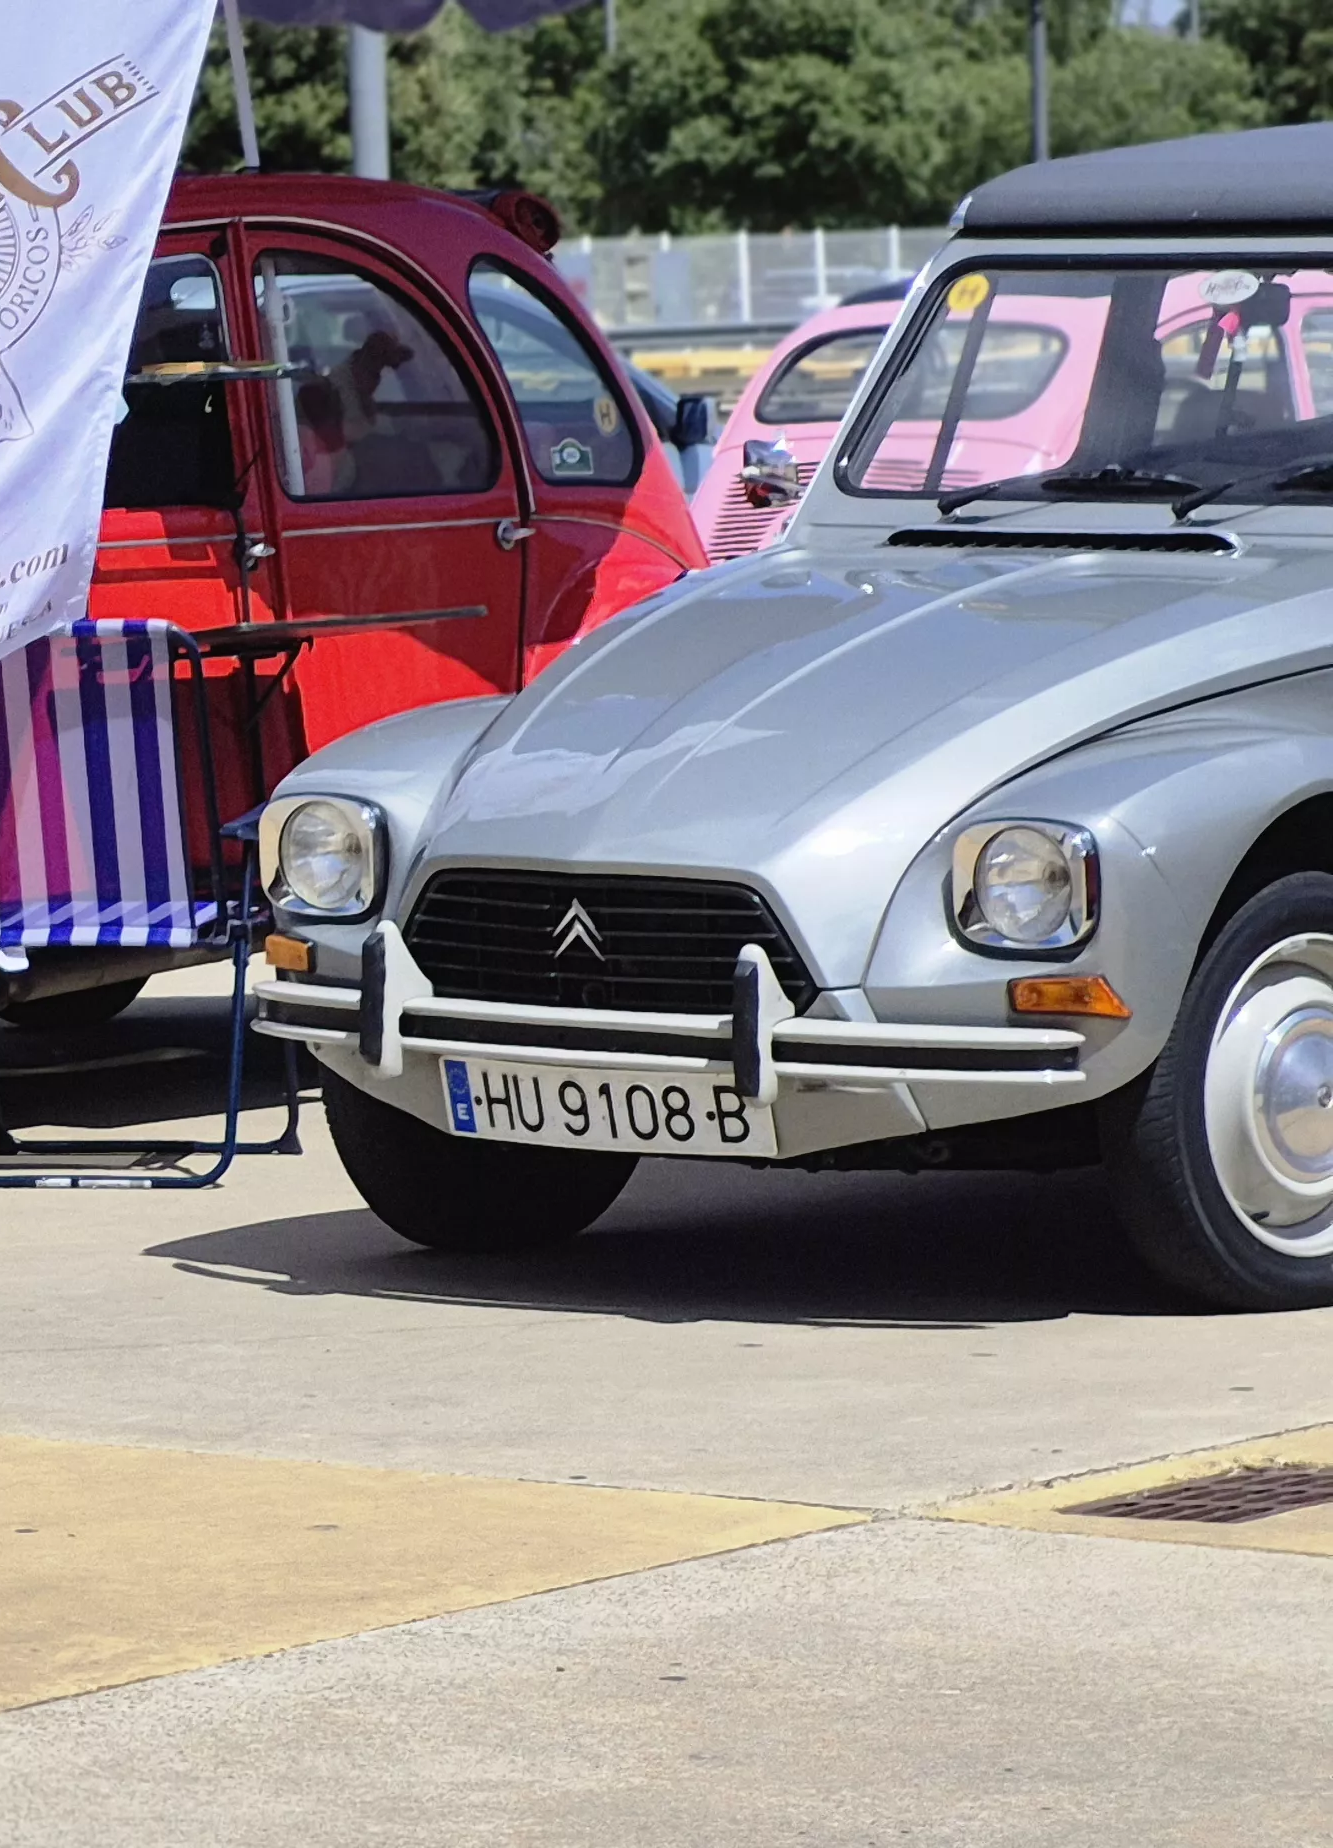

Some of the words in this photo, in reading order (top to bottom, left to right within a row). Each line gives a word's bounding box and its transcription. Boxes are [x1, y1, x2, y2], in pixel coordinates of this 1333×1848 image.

[598, 402, 613, 427] H
[456, 1102, 471, 1120] E
[481, 1071, 545, 1133] HU
[558, 1080, 696, 1142] 9108
[712, 1085, 751, 1143] B
